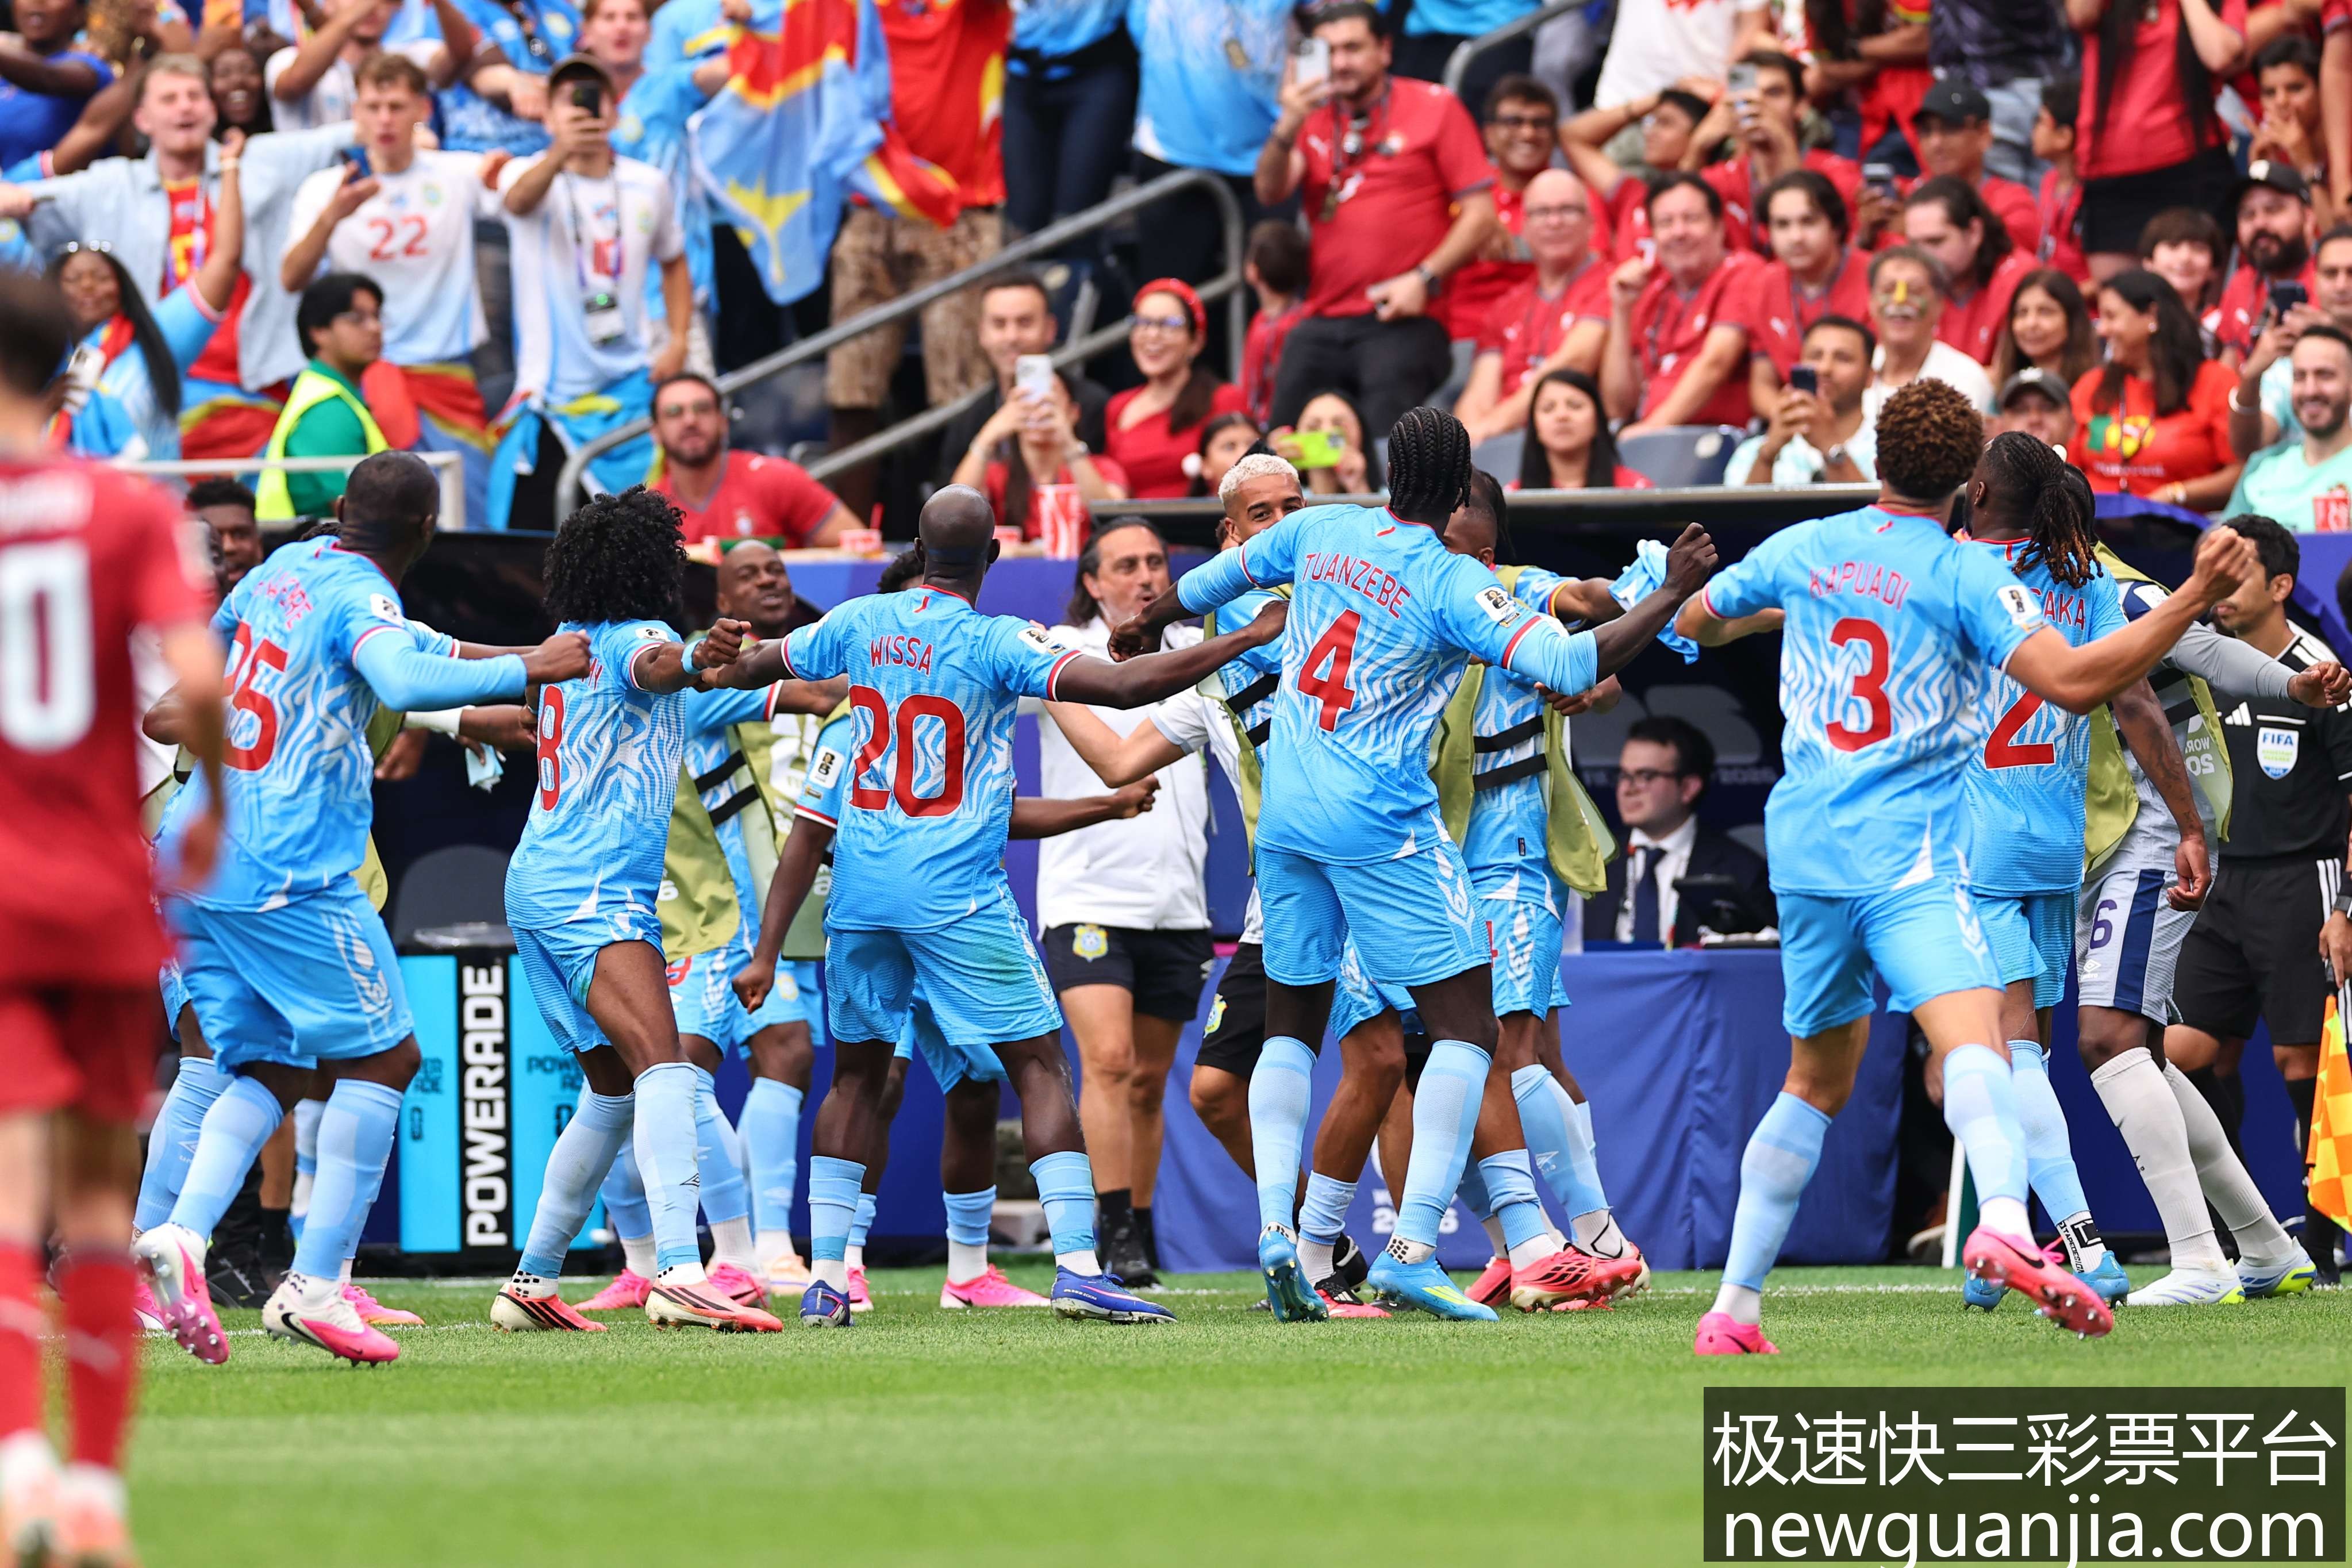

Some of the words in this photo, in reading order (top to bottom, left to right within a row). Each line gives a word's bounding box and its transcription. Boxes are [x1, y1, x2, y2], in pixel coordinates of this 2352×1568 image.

[367, 214, 430, 260] 22
[1301, 552, 1411, 619] TUANZEBE
[1809, 561, 1911, 611] KAPUADI
[870, 635, 933, 677] WISSA
[1297, 608, 1362, 732] 4
[1826, 617, 1892, 752] 3
[537, 684, 565, 812] 8
[848, 684, 967, 818] 20
[1983, 689, 2056, 770] 2
[2262, 732, 2293, 746] FIFA
[2089, 899, 2117, 950] 6
[462, 964, 508, 1247] POWERADE
